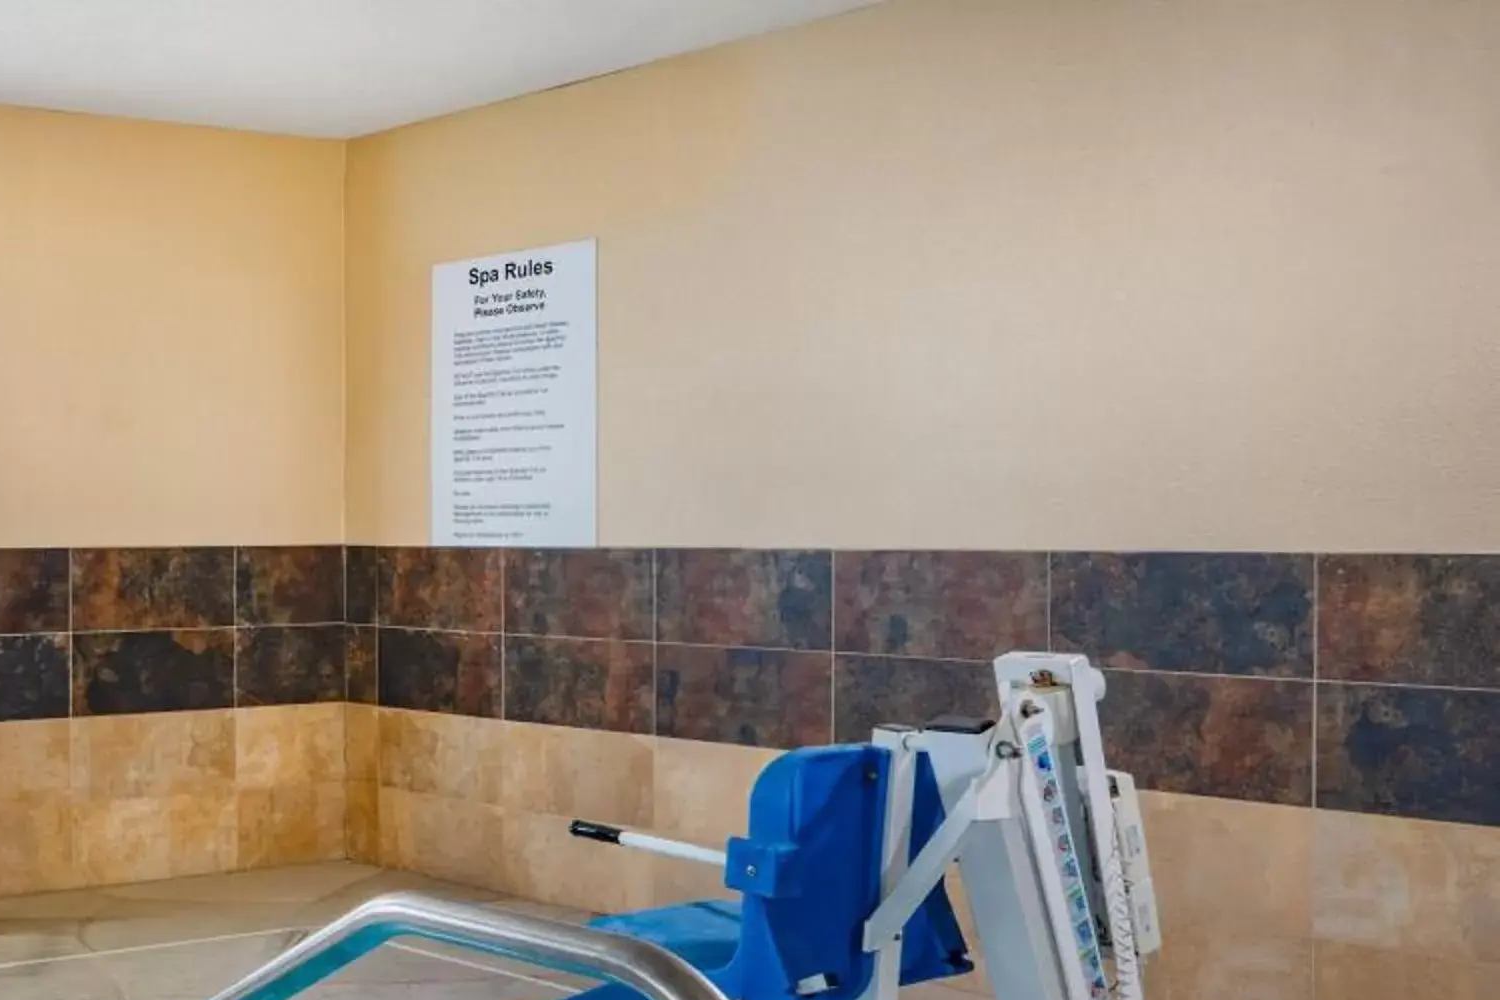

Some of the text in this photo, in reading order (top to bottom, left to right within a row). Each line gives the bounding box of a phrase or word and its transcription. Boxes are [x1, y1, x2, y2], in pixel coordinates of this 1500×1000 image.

[468, 258, 554, 288] Spa Rules
[474, 294, 489, 305] For
[491, 292, 513, 304] Your
[474, 301, 545, 319] Please Observe
